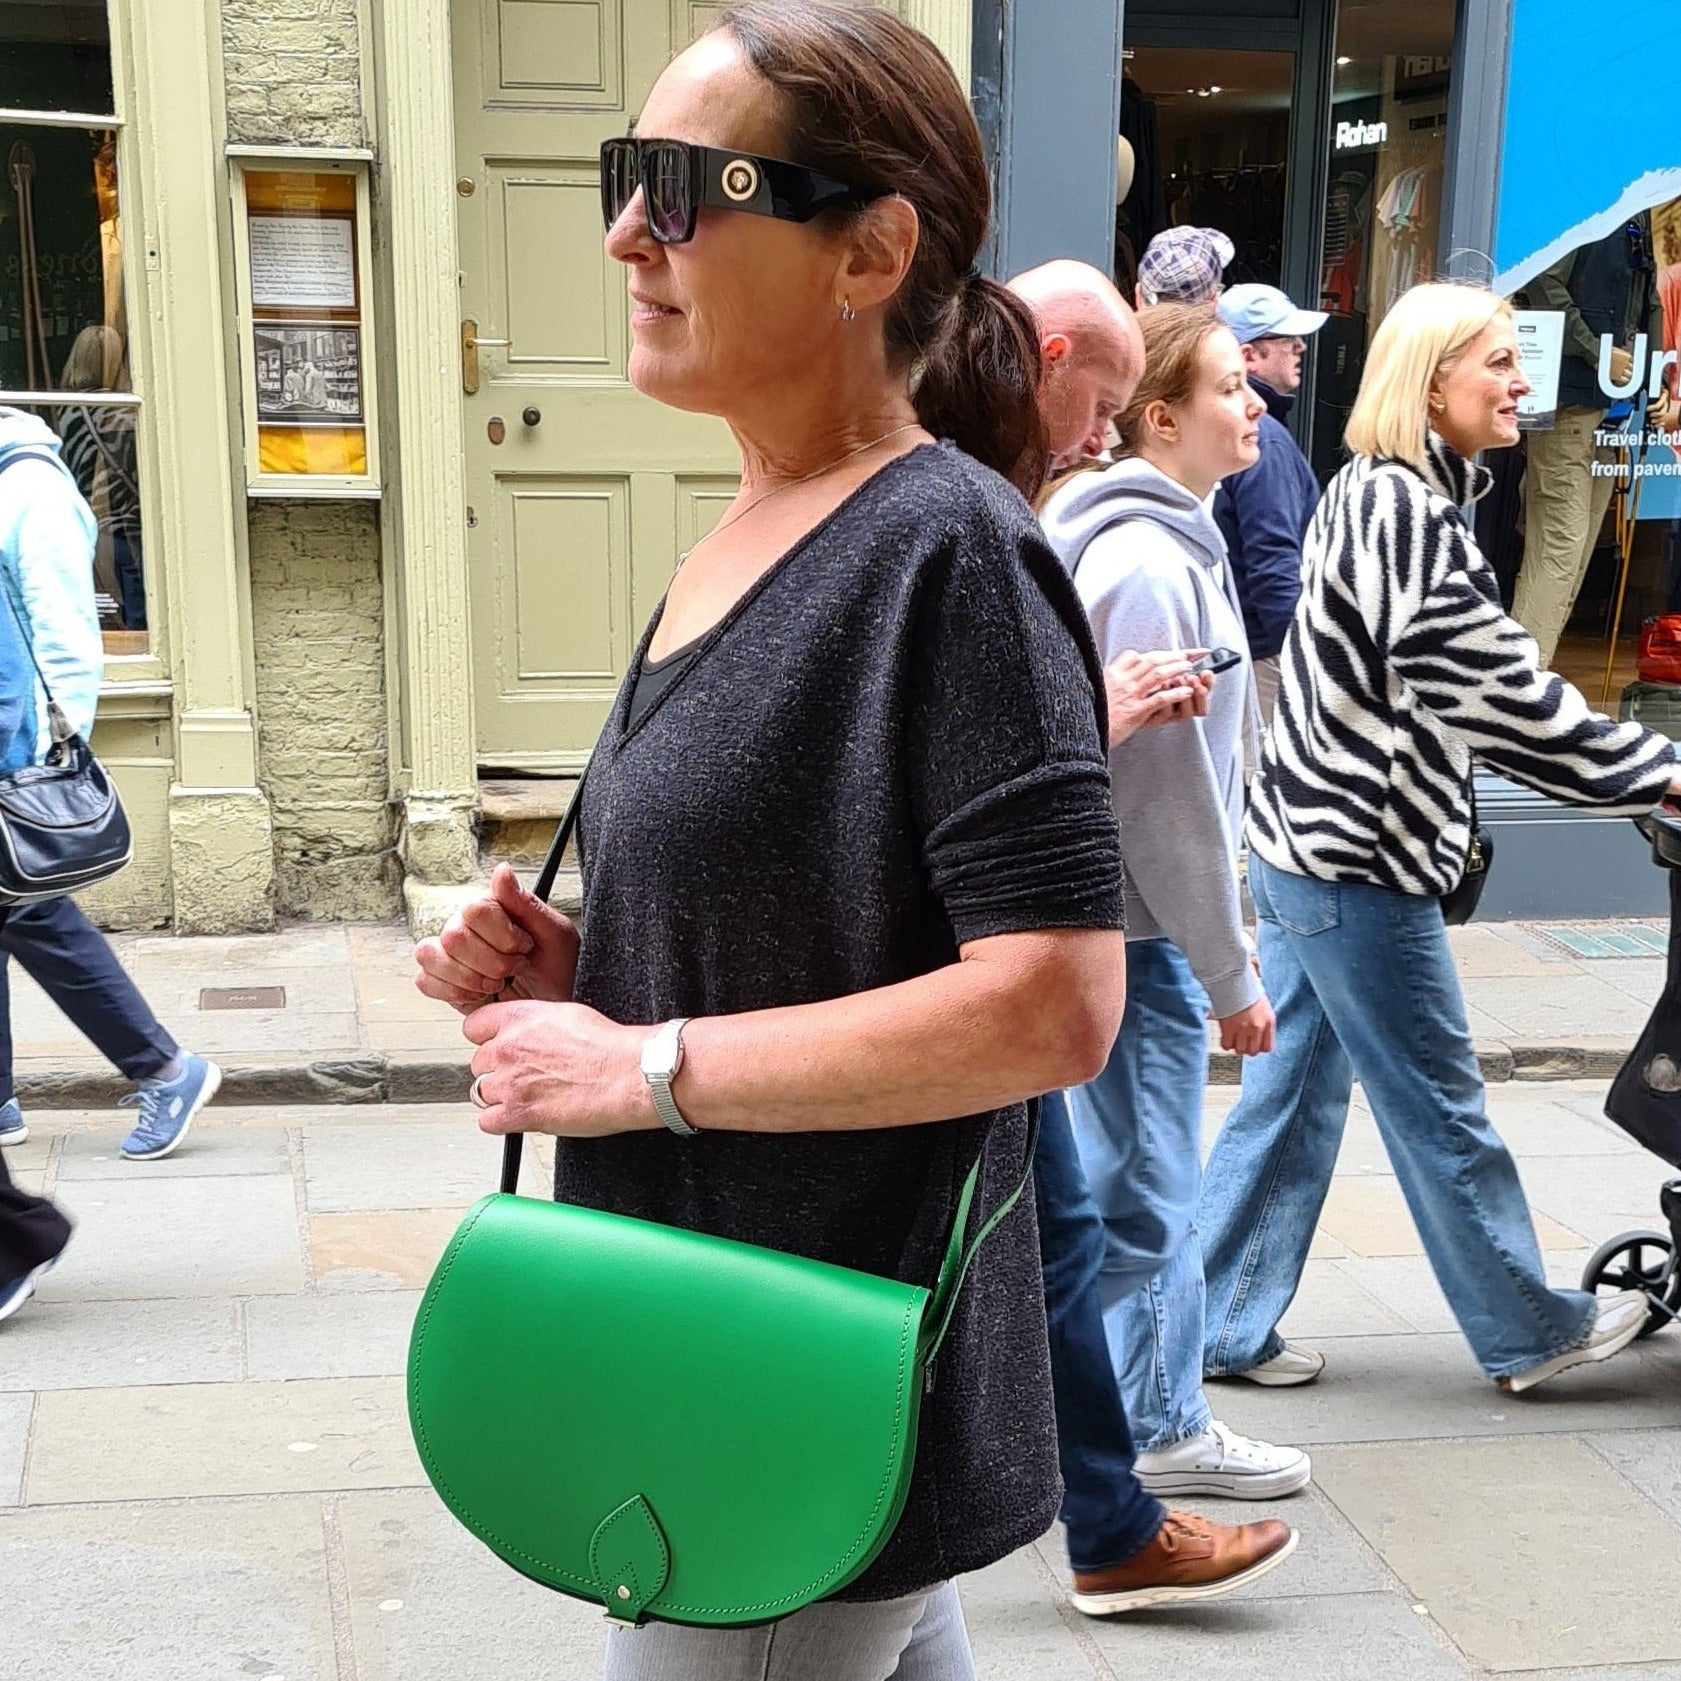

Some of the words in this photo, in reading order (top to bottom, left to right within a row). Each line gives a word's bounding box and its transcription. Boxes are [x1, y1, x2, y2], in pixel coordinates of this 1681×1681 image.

[1336, 119, 1388, 149] Rohan
[1597, 332, 1681, 400] Ur
[1593, 429, 1643, 447] Travel
[1590, 460, 1629, 477] from
